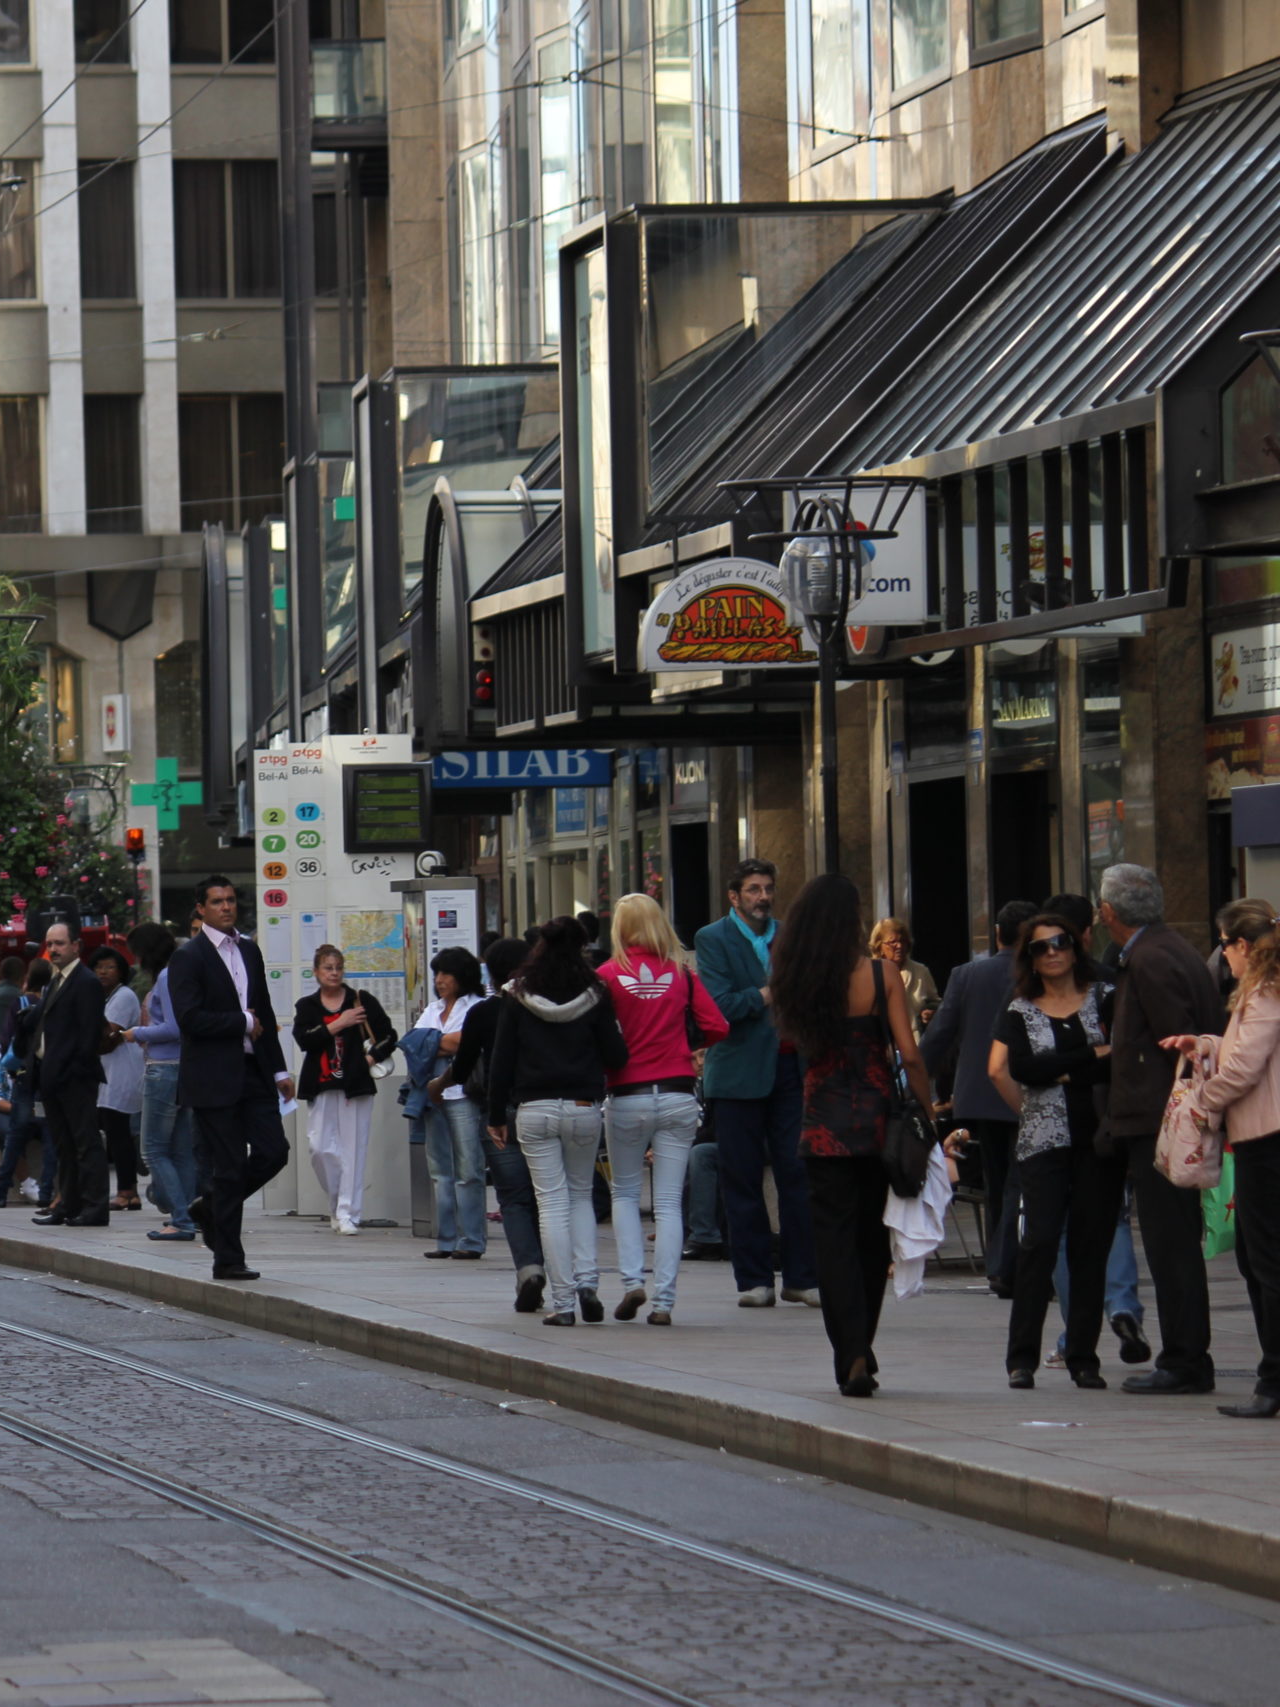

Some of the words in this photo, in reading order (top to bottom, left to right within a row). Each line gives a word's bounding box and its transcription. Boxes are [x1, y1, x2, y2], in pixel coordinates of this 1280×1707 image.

[675, 582, 690, 601] Le
[697, 595, 765, 619] PAIN
[432, 749, 590, 780] SILAB
[269, 811, 279, 823] 2
[299, 806, 315, 818] 17
[269, 838, 280, 850] 7
[299, 833, 318, 846] 20
[267, 865, 283, 877] 12
[299, 861, 318, 874] 36
[267, 893, 284, 904] 16
